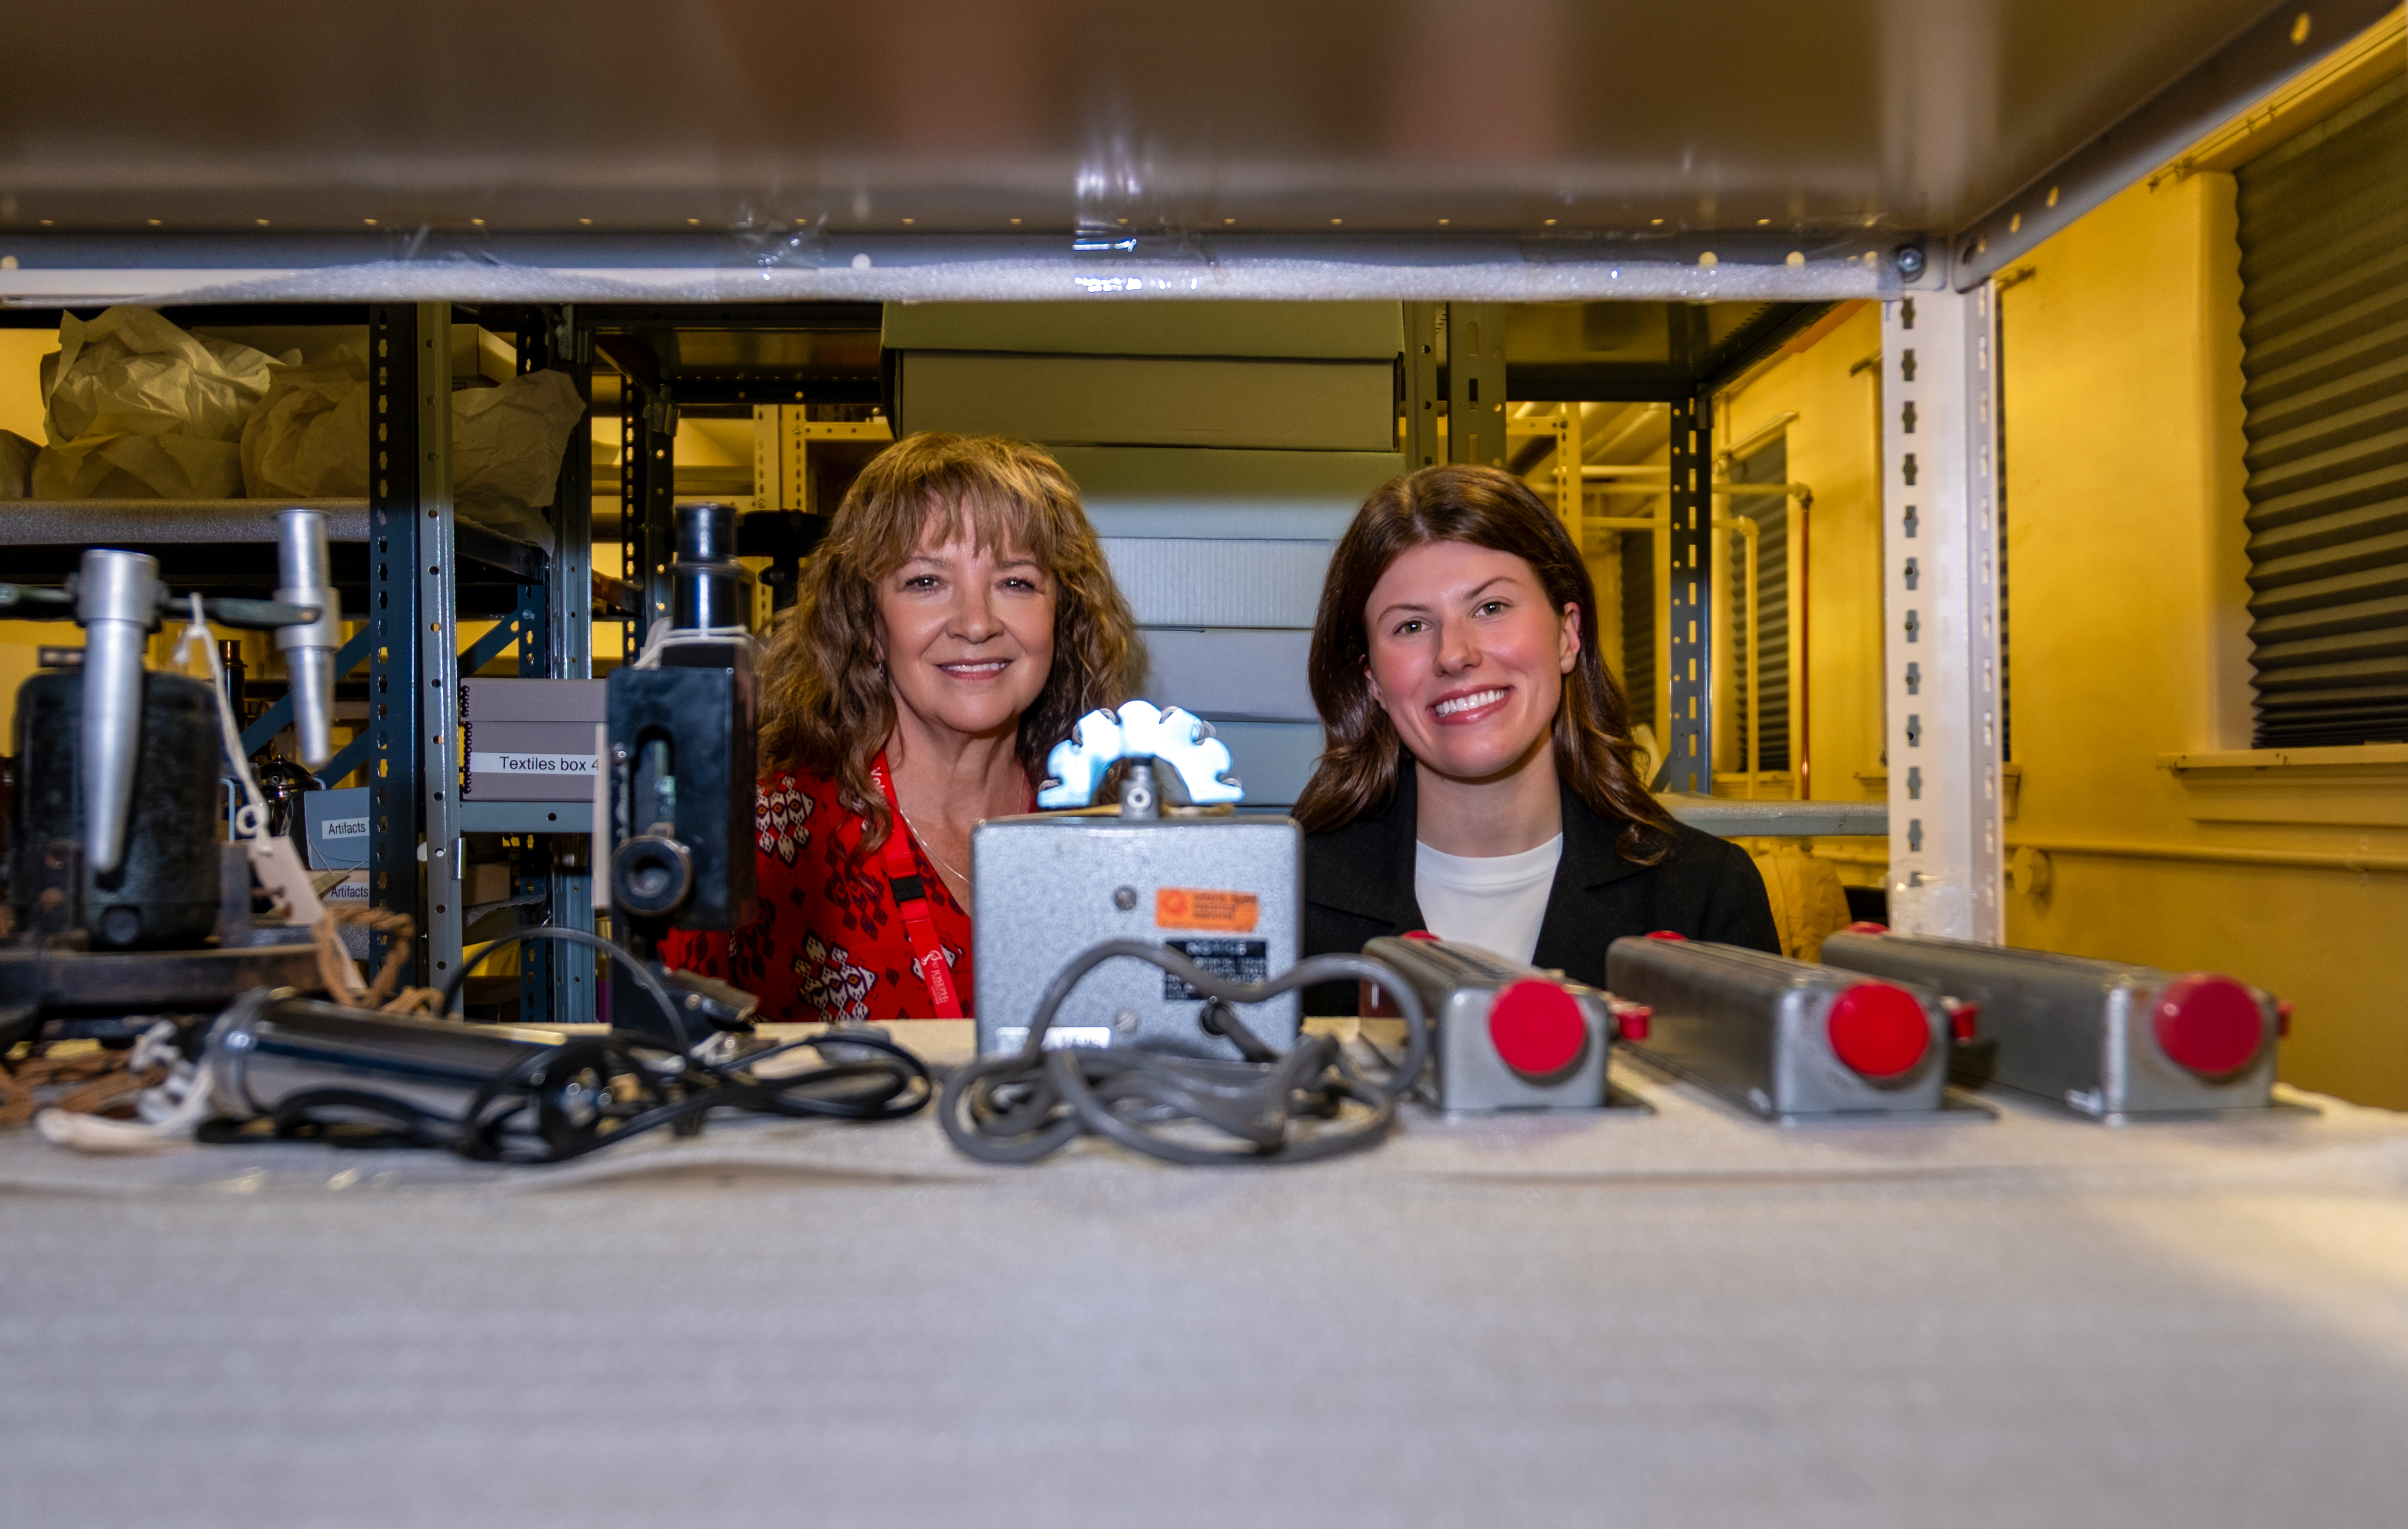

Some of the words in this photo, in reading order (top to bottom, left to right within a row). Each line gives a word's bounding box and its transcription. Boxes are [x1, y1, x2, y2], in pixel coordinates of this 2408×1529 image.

[499, 756, 555, 770] Textiles
[561, 758, 586, 771] box
[329, 822, 366, 835] Artifacts
[331, 885, 369, 897] Artifacts
